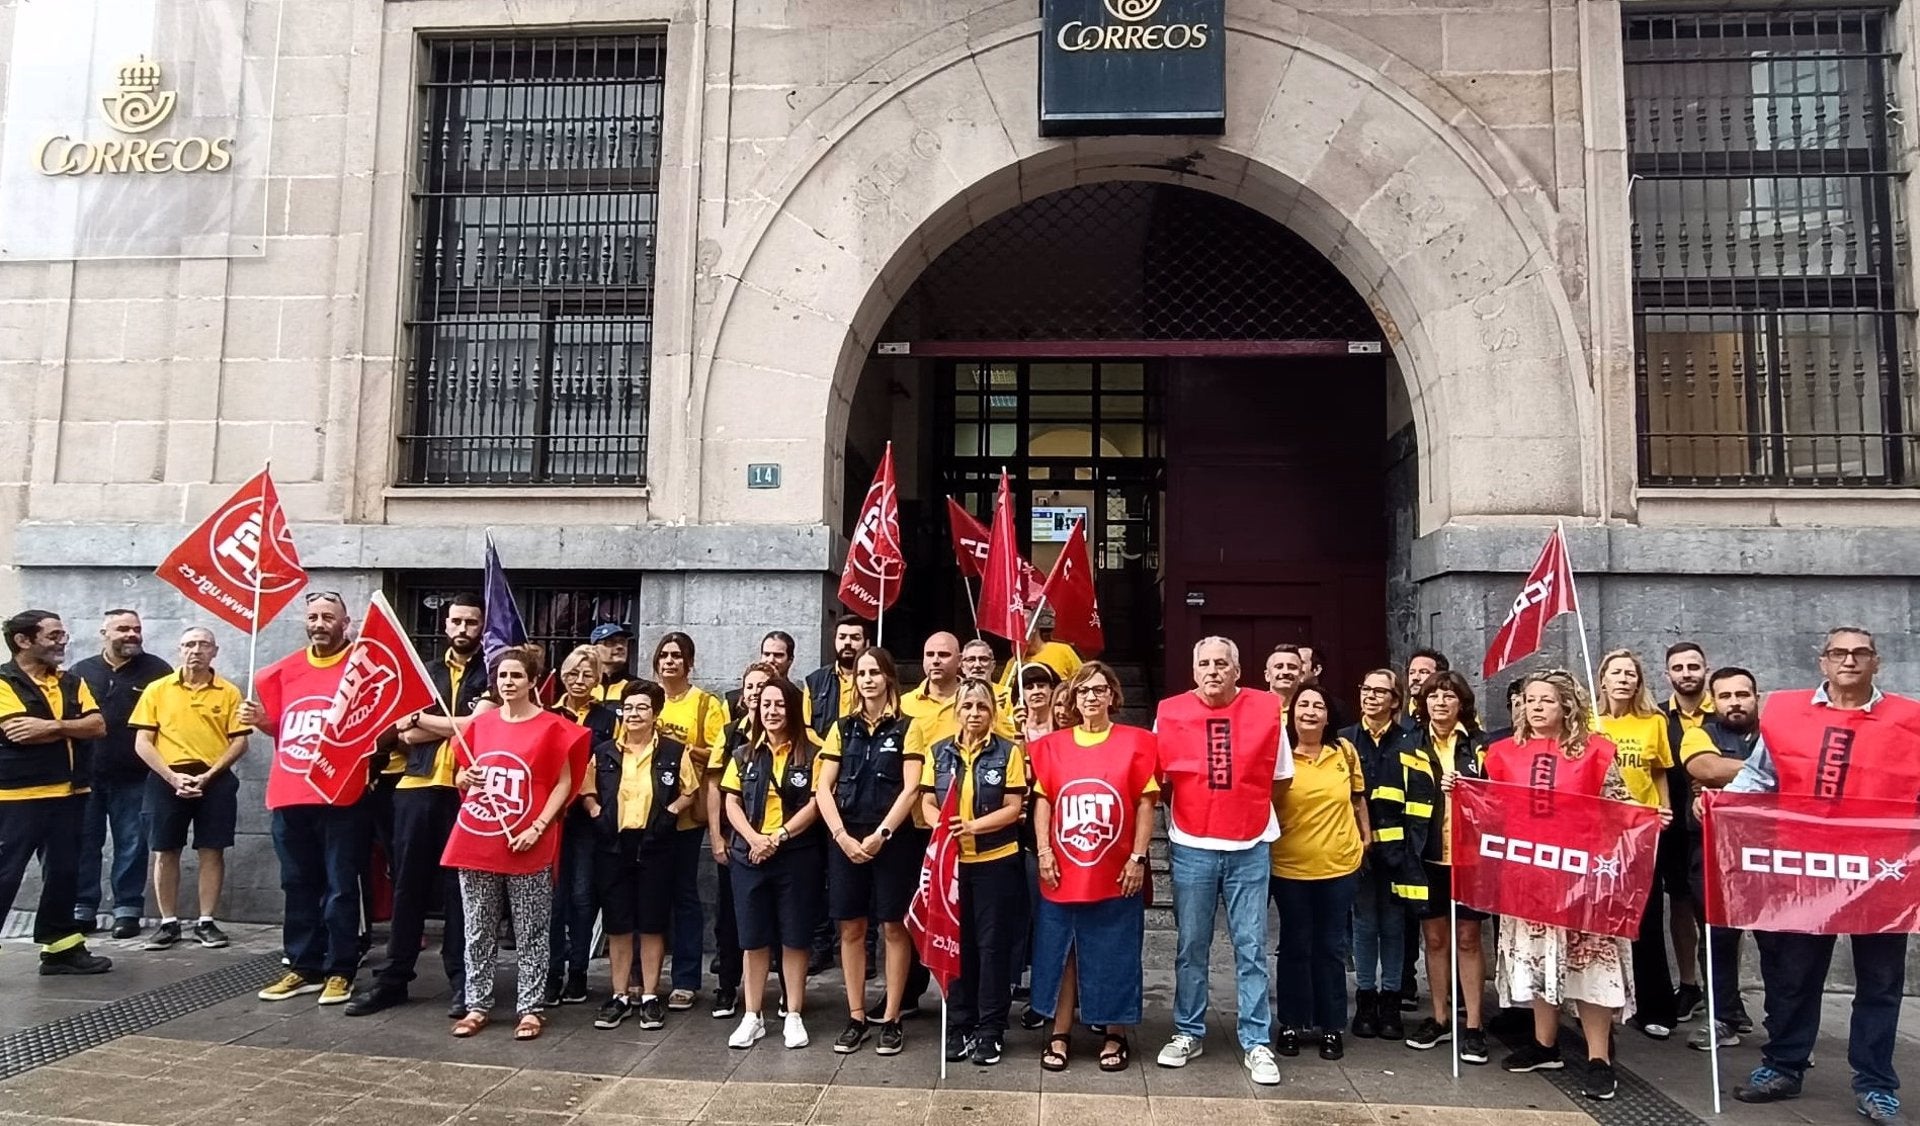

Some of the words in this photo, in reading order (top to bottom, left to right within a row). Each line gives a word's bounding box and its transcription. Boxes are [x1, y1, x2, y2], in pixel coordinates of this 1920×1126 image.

[1057, 21, 1208, 51] CORREOS
[31, 135, 235, 176] CORREOS
[755, 467, 772, 482] 14
[1061, 793, 1115, 831] UGT
[1480, 833, 1589, 875] CCOO
[1741, 847, 1870, 881] CCOO
